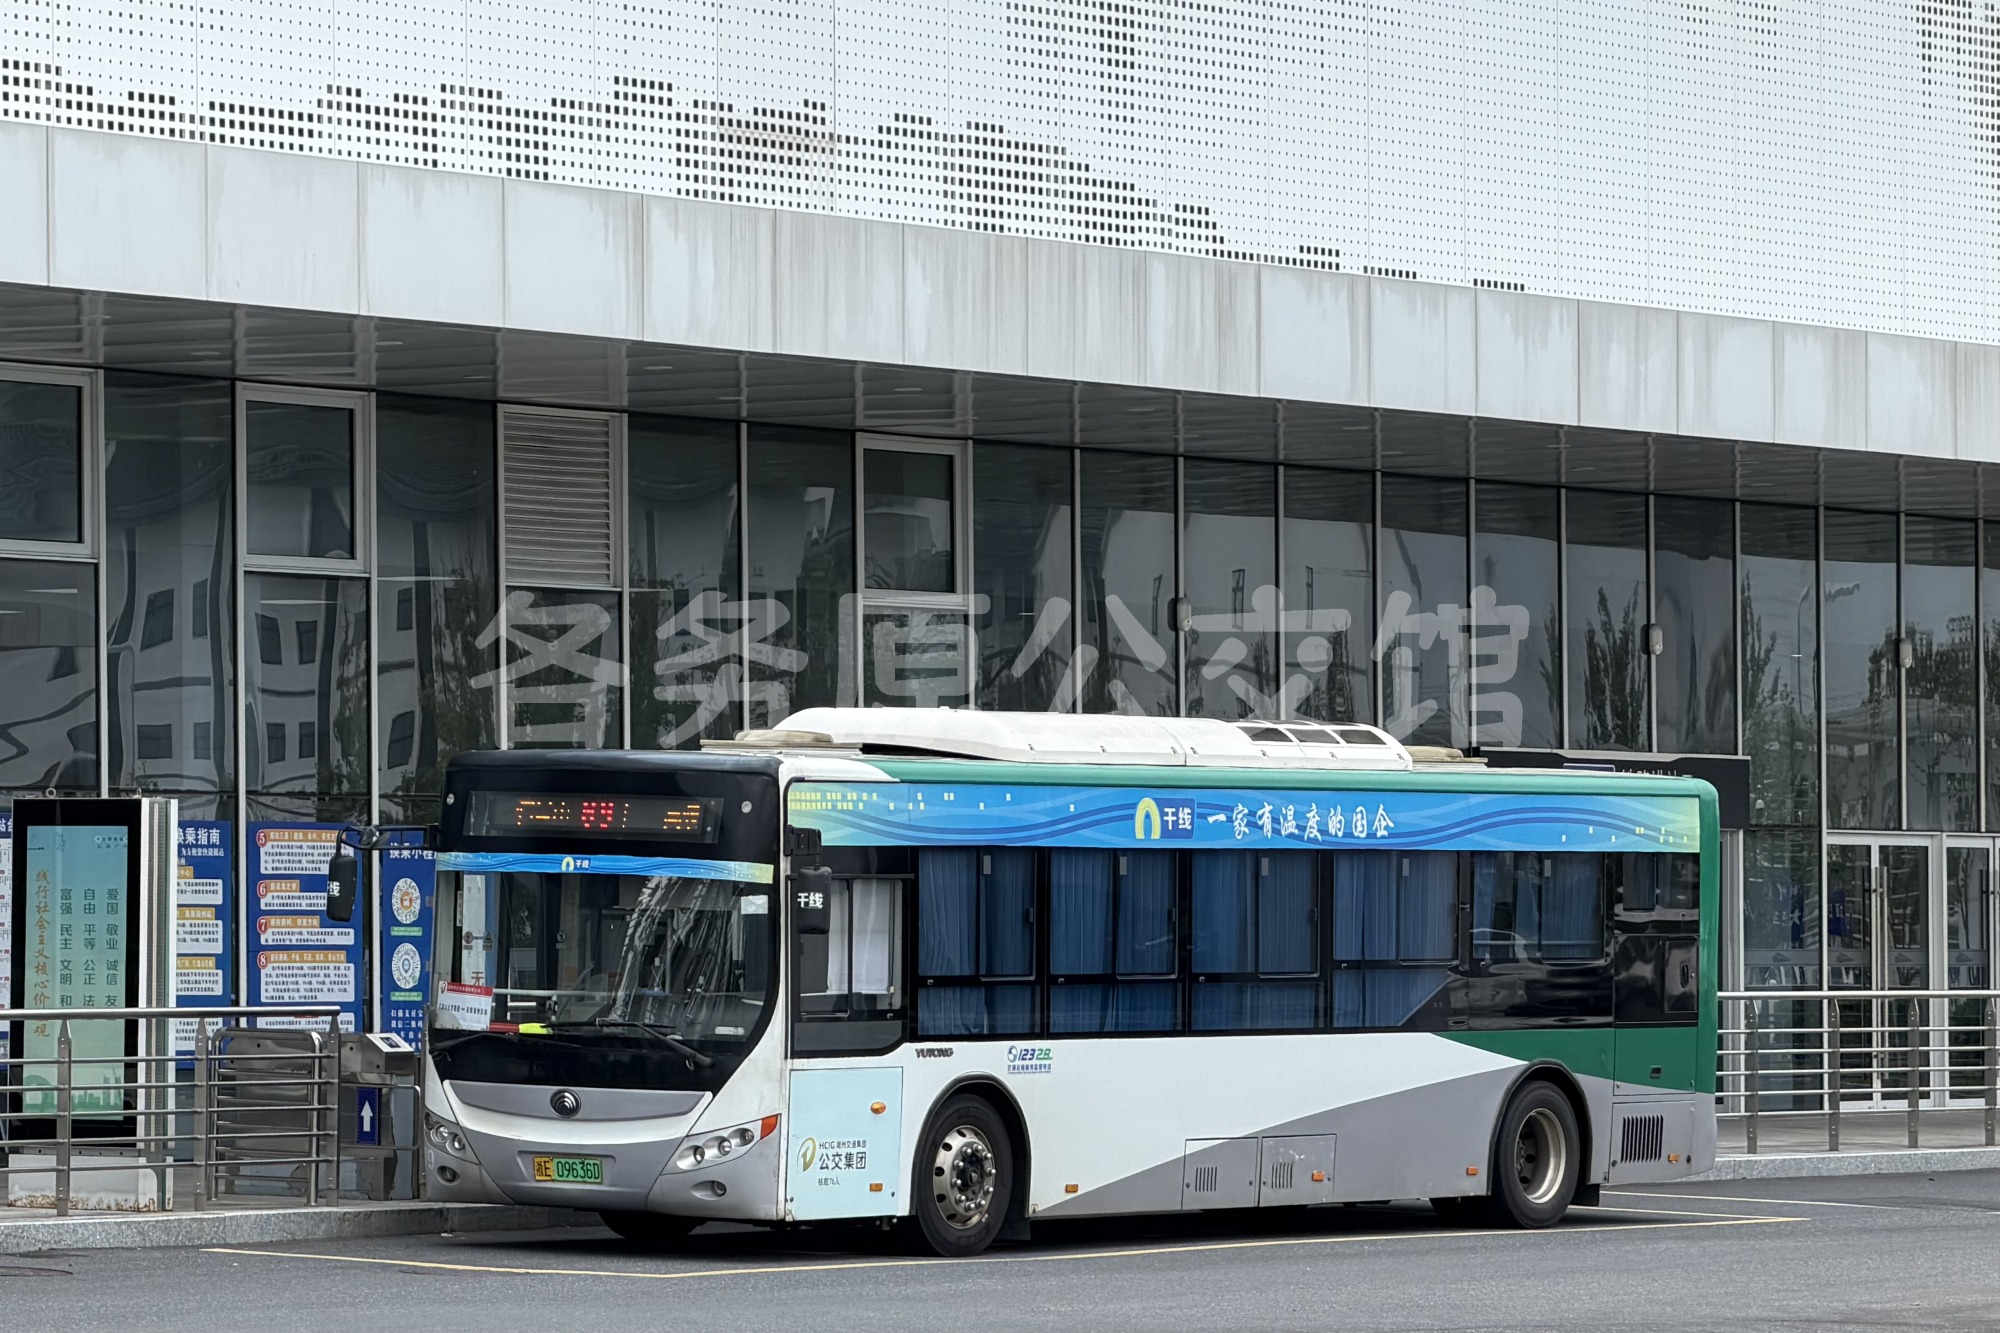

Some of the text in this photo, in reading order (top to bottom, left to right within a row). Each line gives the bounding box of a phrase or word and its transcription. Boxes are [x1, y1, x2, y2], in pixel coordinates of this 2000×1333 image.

[1163, 802, 1394, 842] 干线 一家有温度的国企
[259, 833, 266, 846] 5
[259, 883, 266, 896] 6
[327, 881, 341, 896] 线
[60, 888, 73, 915] 富强
[83, 888, 96, 915] 自由
[106, 888, 119, 915] 爱国
[797, 892, 824, 909] 干线
[259, 918, 266, 931] 7
[60, 923, 73, 950] 民主
[83, 923, 96, 950] 平等
[106, 923, 118, 950] 敬业
[34, 869, 51, 1038] 践行社会主义核心价观
[259, 953, 266, 967] 8
[60, 959, 73, 986] 文明
[83, 959, 96, 985] 公正
[106, 959, 118, 986] 诚信
[914, 1047, 954, 1059] YUTONG
[1017, 1048, 1052, 1061] 12328
[819, 1141, 835, 1150] HCIG
[556, 1160, 600, 1180] 09636D
[818, 1151, 867, 1171] 公交集团
